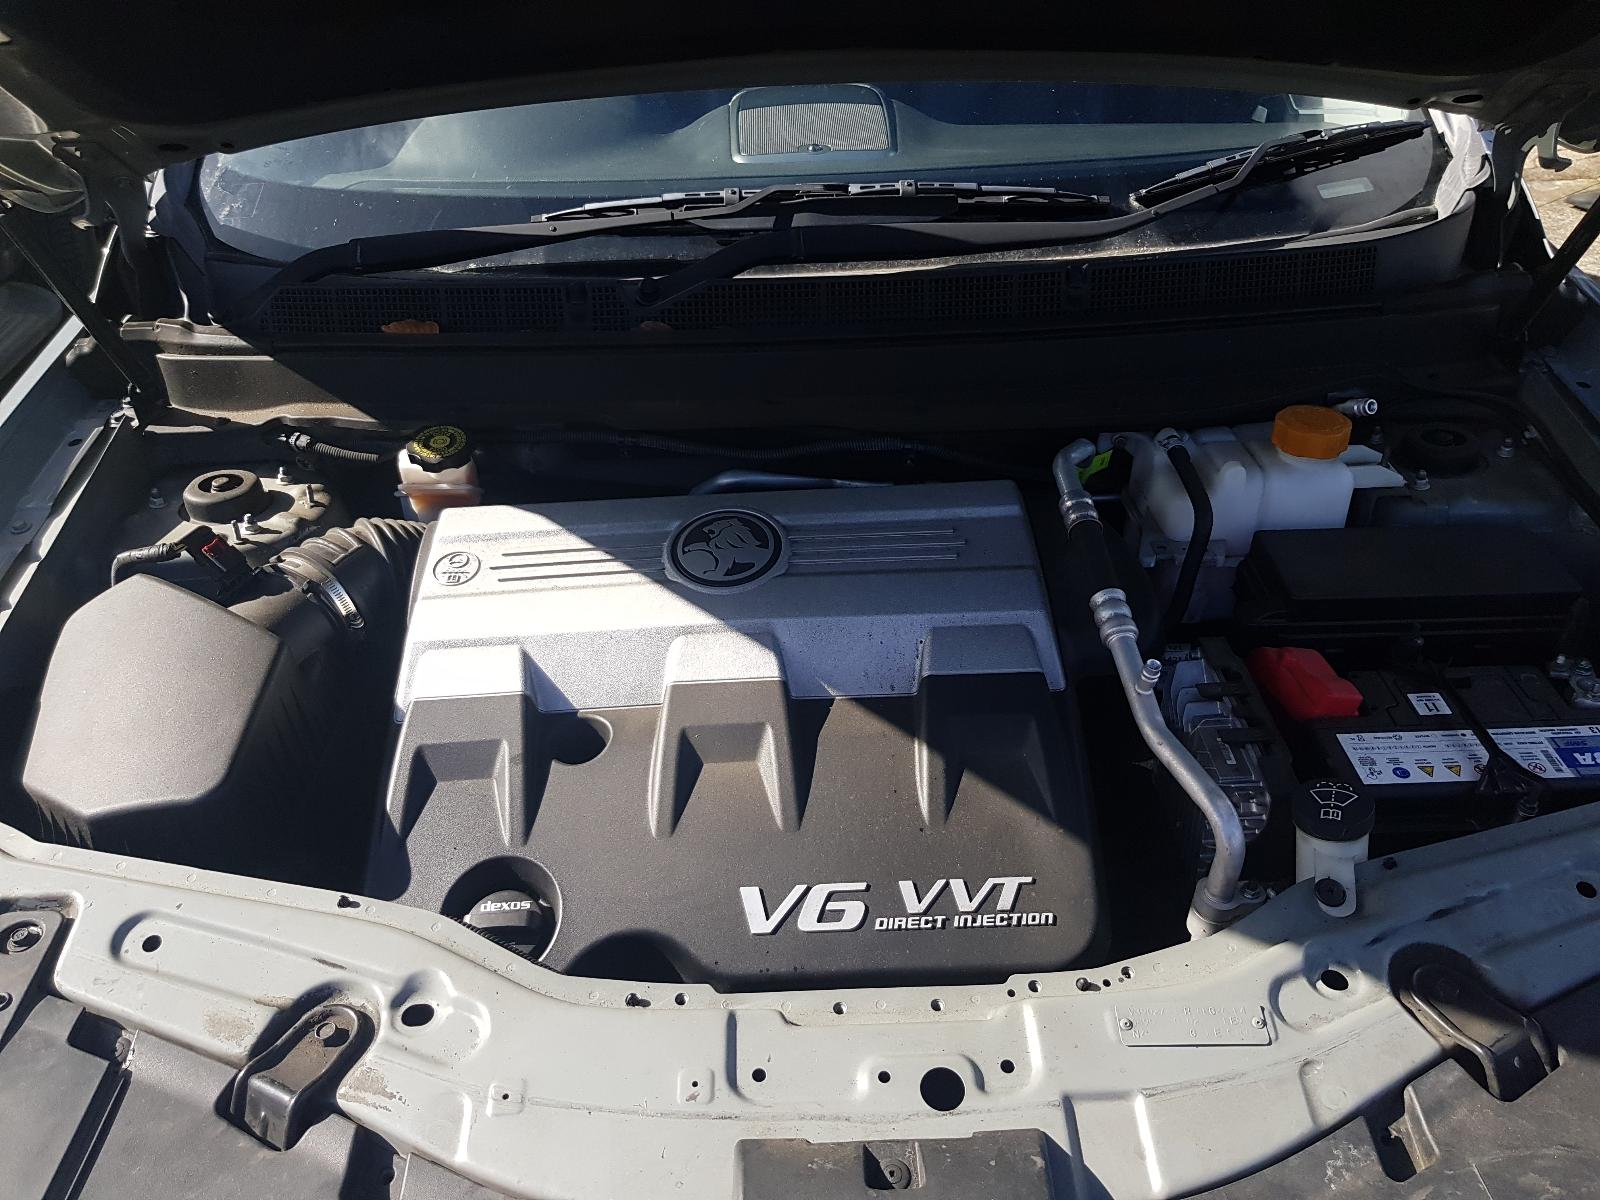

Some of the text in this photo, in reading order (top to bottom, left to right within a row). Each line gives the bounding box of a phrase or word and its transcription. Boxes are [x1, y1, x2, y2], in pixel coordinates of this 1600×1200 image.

[480, 900, 534, 912] dexos
[740, 877, 1034, 935] V6 VVT
[874, 912, 1055, 930] DIRECT INJECTION
